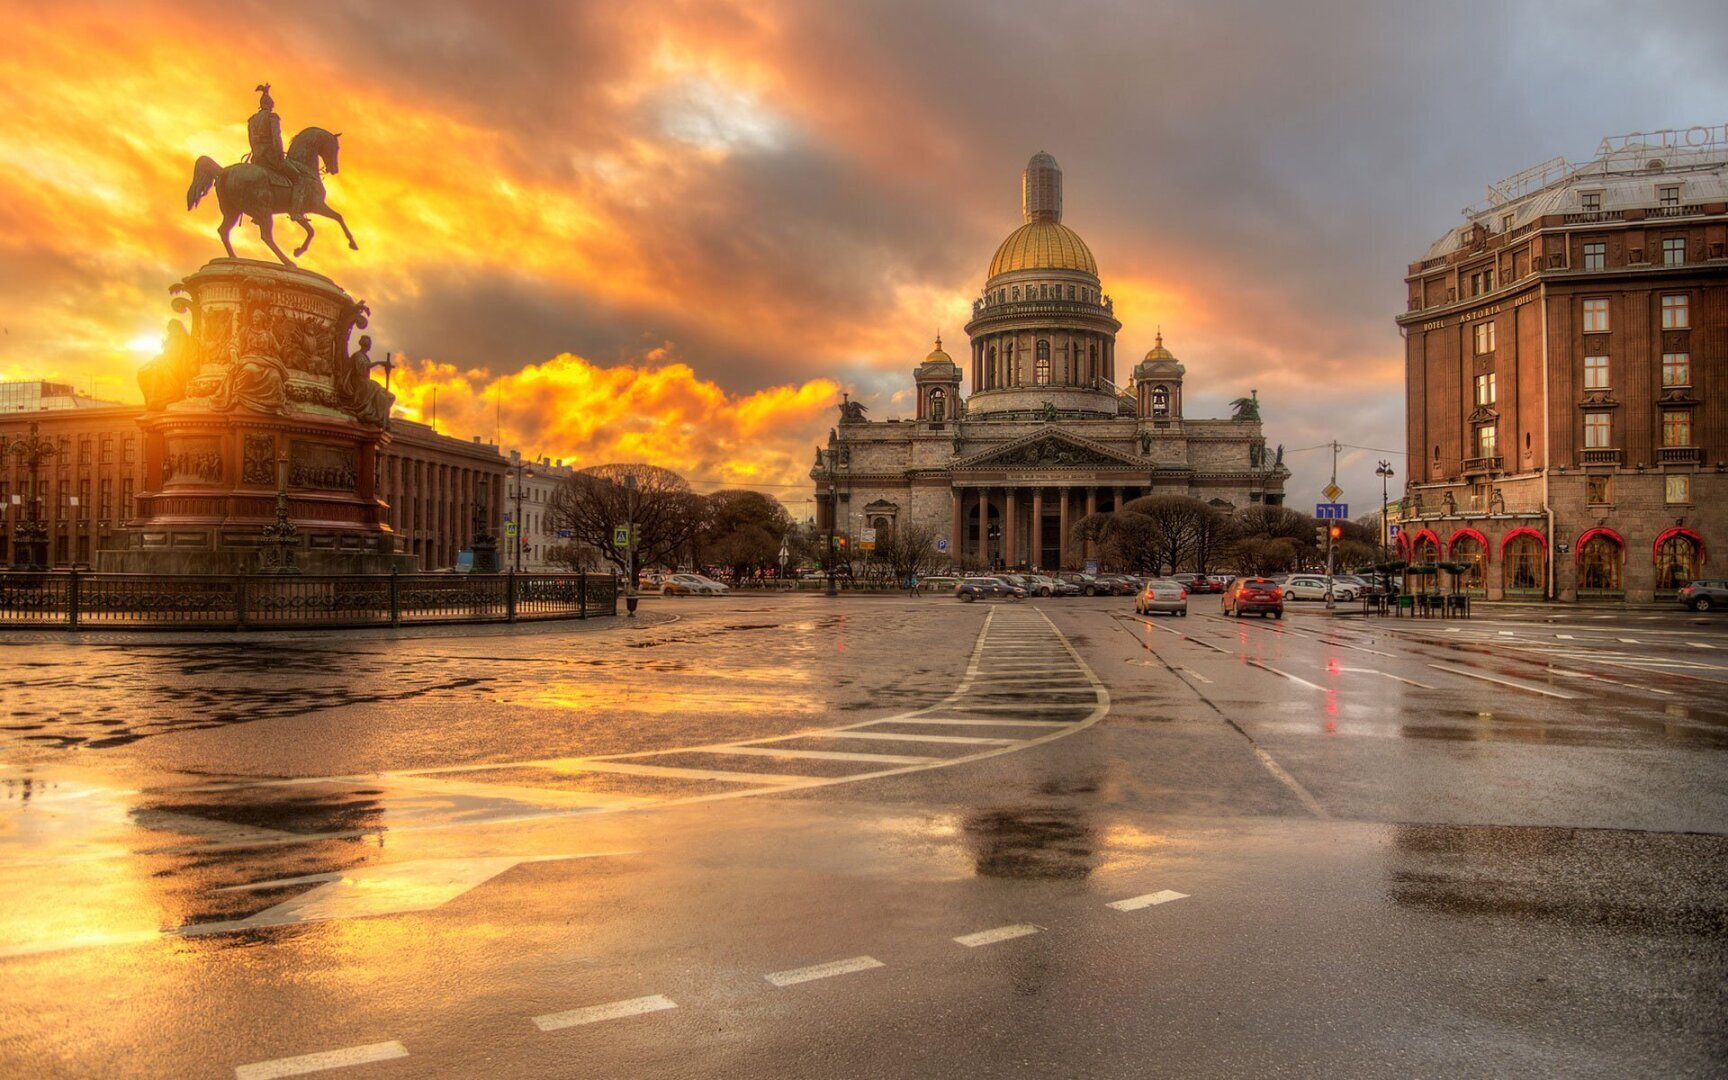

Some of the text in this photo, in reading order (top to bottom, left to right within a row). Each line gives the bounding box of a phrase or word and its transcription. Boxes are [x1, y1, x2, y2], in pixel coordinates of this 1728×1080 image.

[1423, 293, 1533, 331] HOTEL ASTORIA HOTEL
